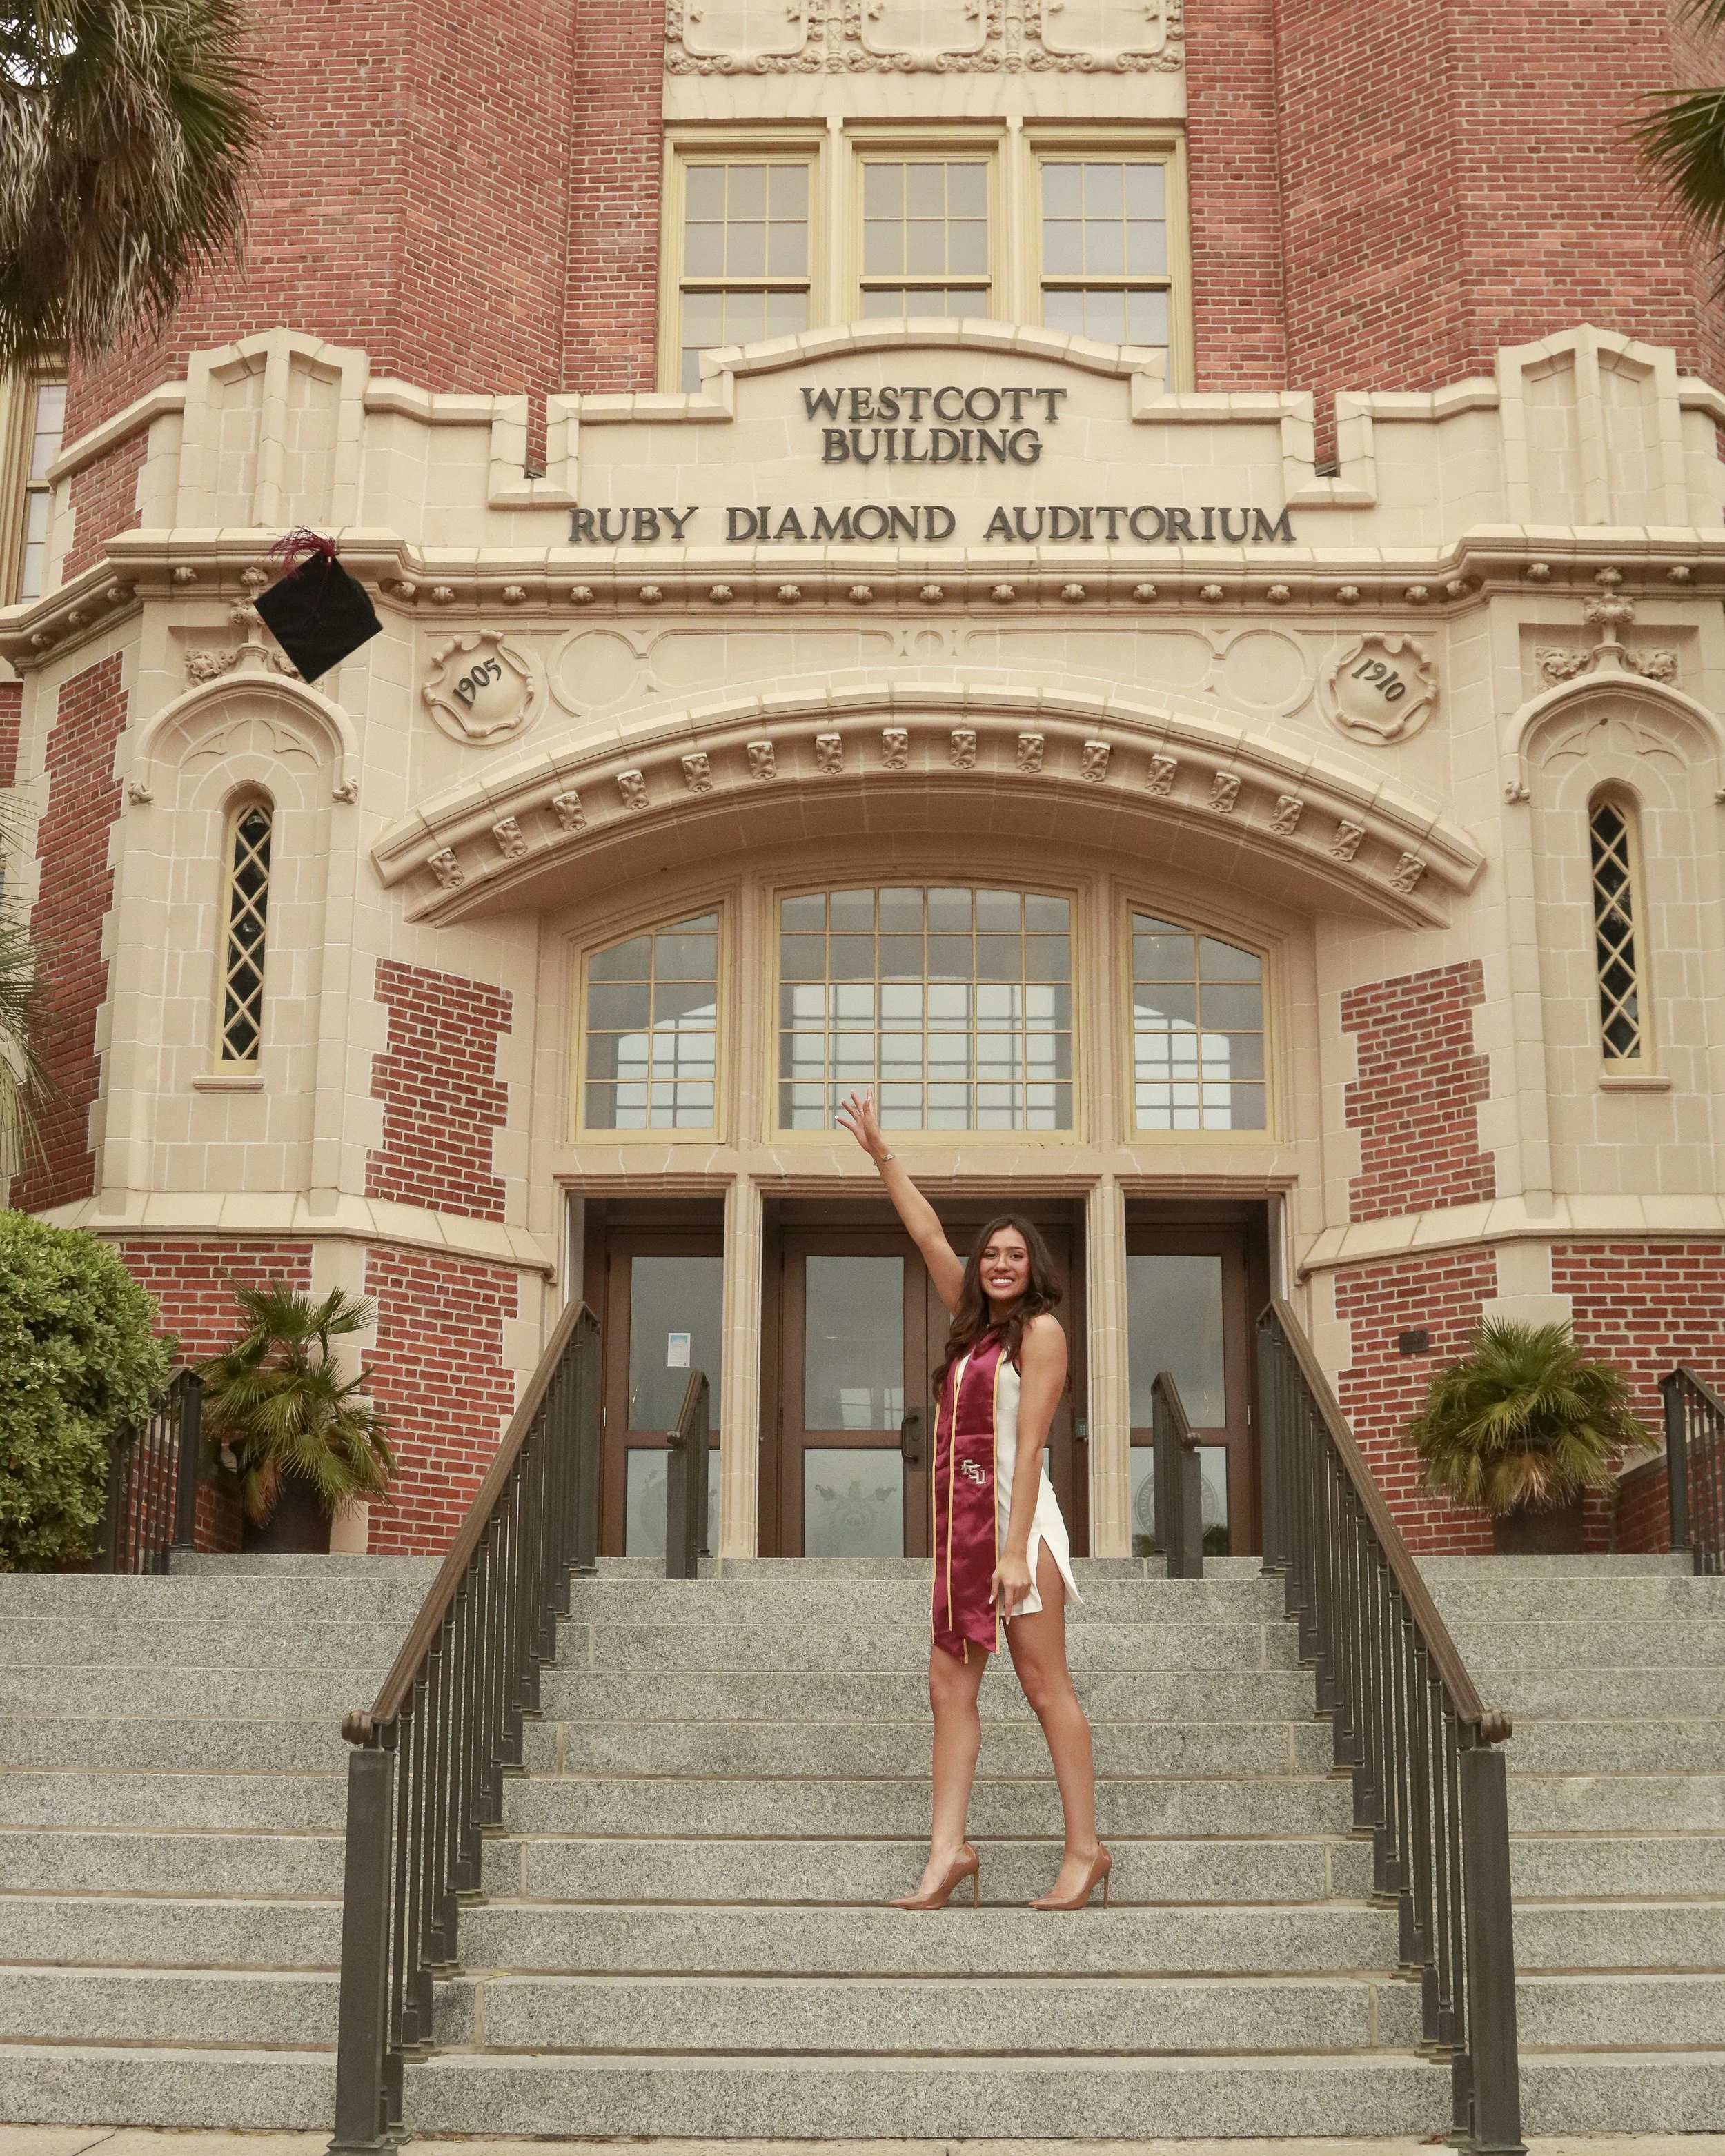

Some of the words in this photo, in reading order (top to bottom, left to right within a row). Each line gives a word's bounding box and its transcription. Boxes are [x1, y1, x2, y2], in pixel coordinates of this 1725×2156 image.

[800, 386, 1067, 421] WESTCOTT
[822, 428, 1043, 463] BUILDING
[568, 506, 699, 542] RUBY
[725, 505, 956, 541] DIAMOND
[983, 505, 1297, 542] AUDITORIUM
[453, 657, 502, 711] 1905
[1351, 658, 1406, 702] 1910
[961, 1459, 987, 1485] FSU
